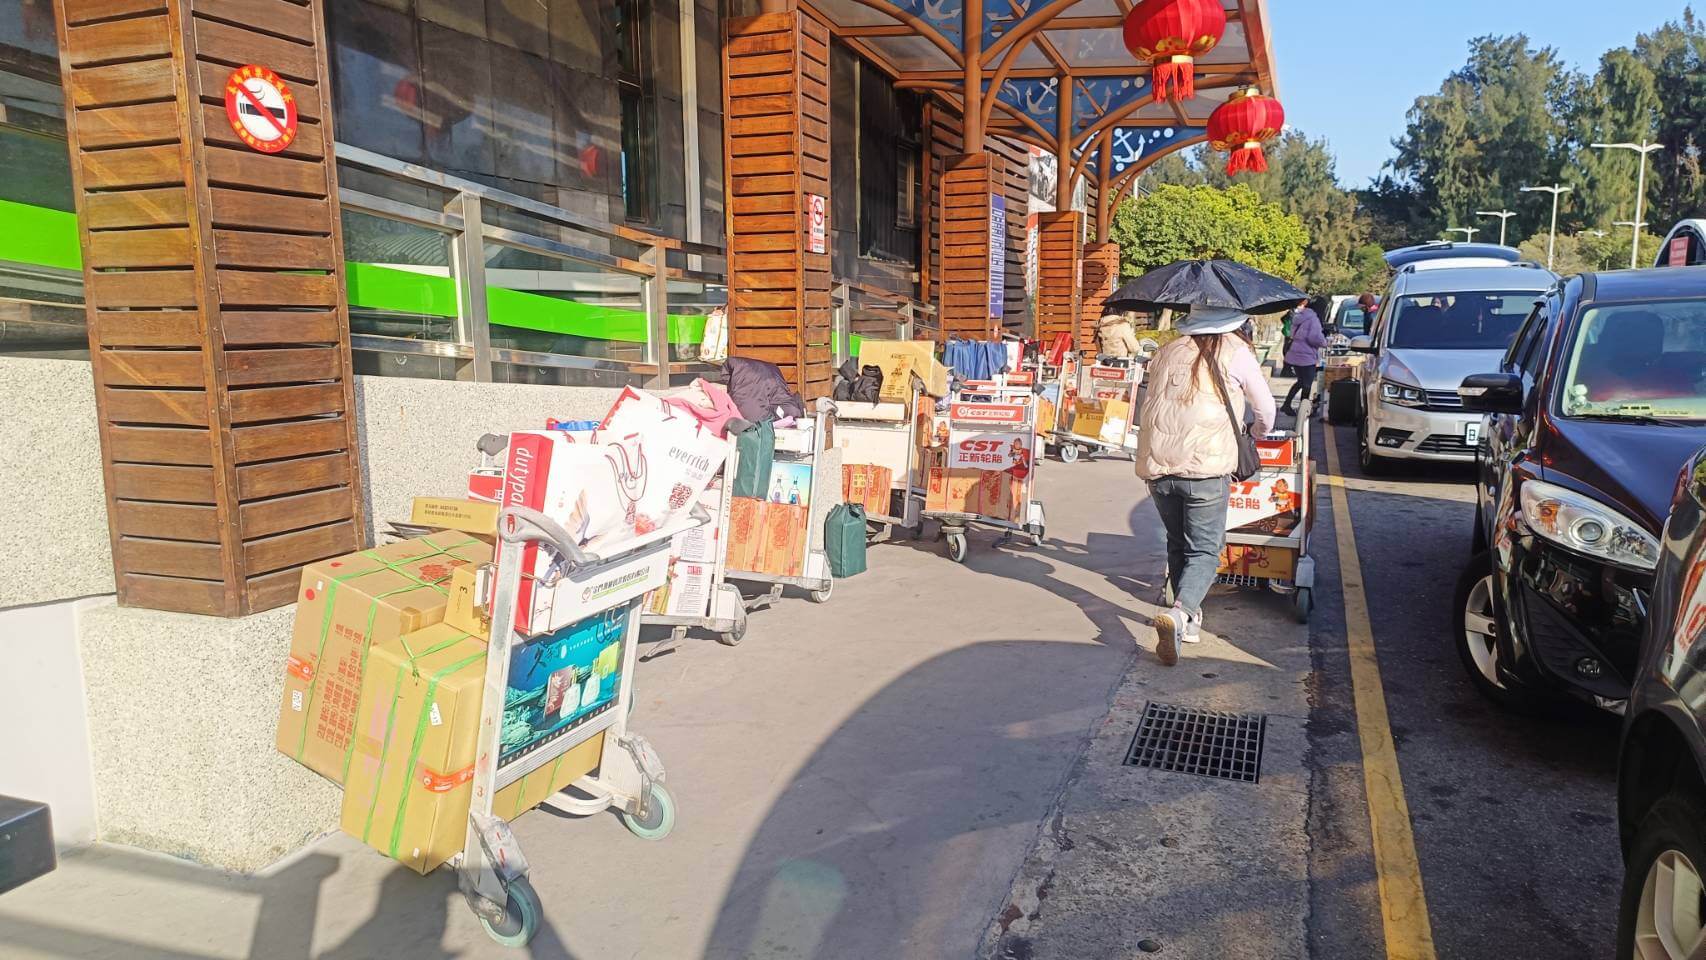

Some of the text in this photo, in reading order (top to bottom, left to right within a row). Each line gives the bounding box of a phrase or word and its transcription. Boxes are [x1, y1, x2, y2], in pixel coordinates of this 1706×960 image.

[960, 439, 1004, 452] CST
[668, 446, 710, 473] everrich
[958, 452, 1003, 465] 正新轮胎
